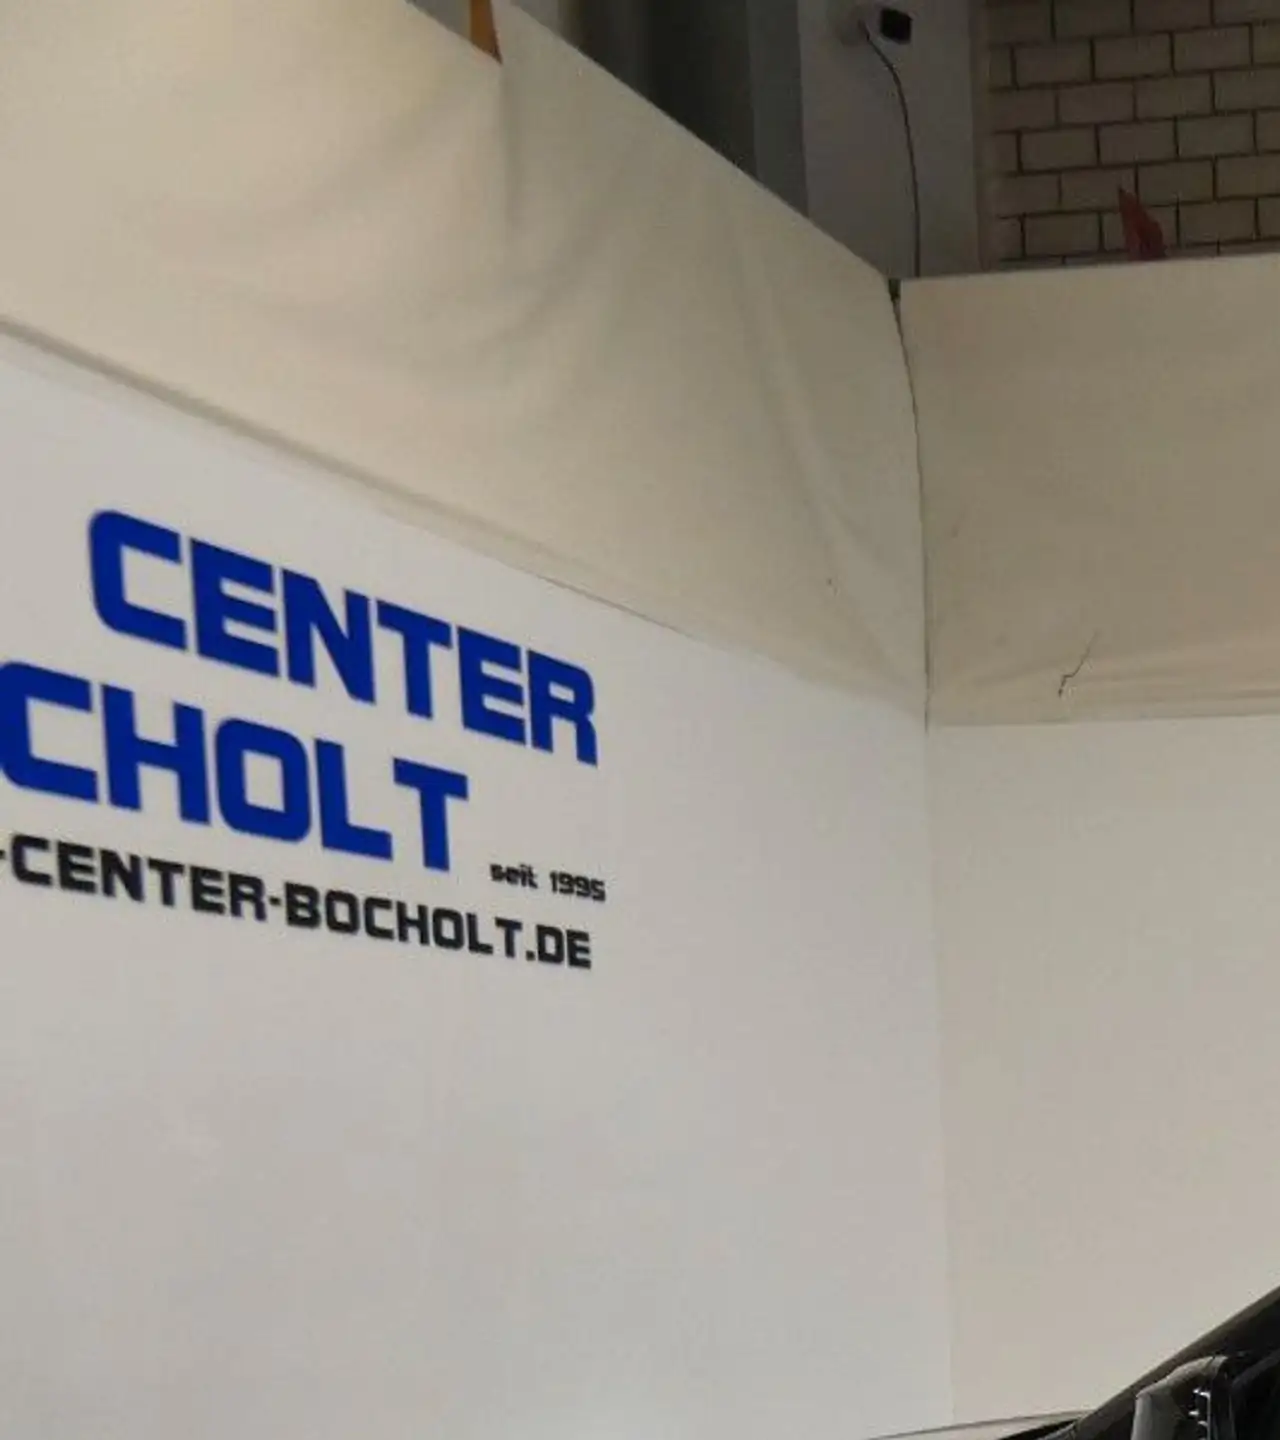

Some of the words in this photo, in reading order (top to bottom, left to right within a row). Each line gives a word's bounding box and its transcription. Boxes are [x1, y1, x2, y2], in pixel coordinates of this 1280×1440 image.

[89, 510, 598, 766] CENTER
[0, 662, 469, 872] CHOLT
[489, 863, 538, 889] seit
[549, 870, 606, 902] 1995
